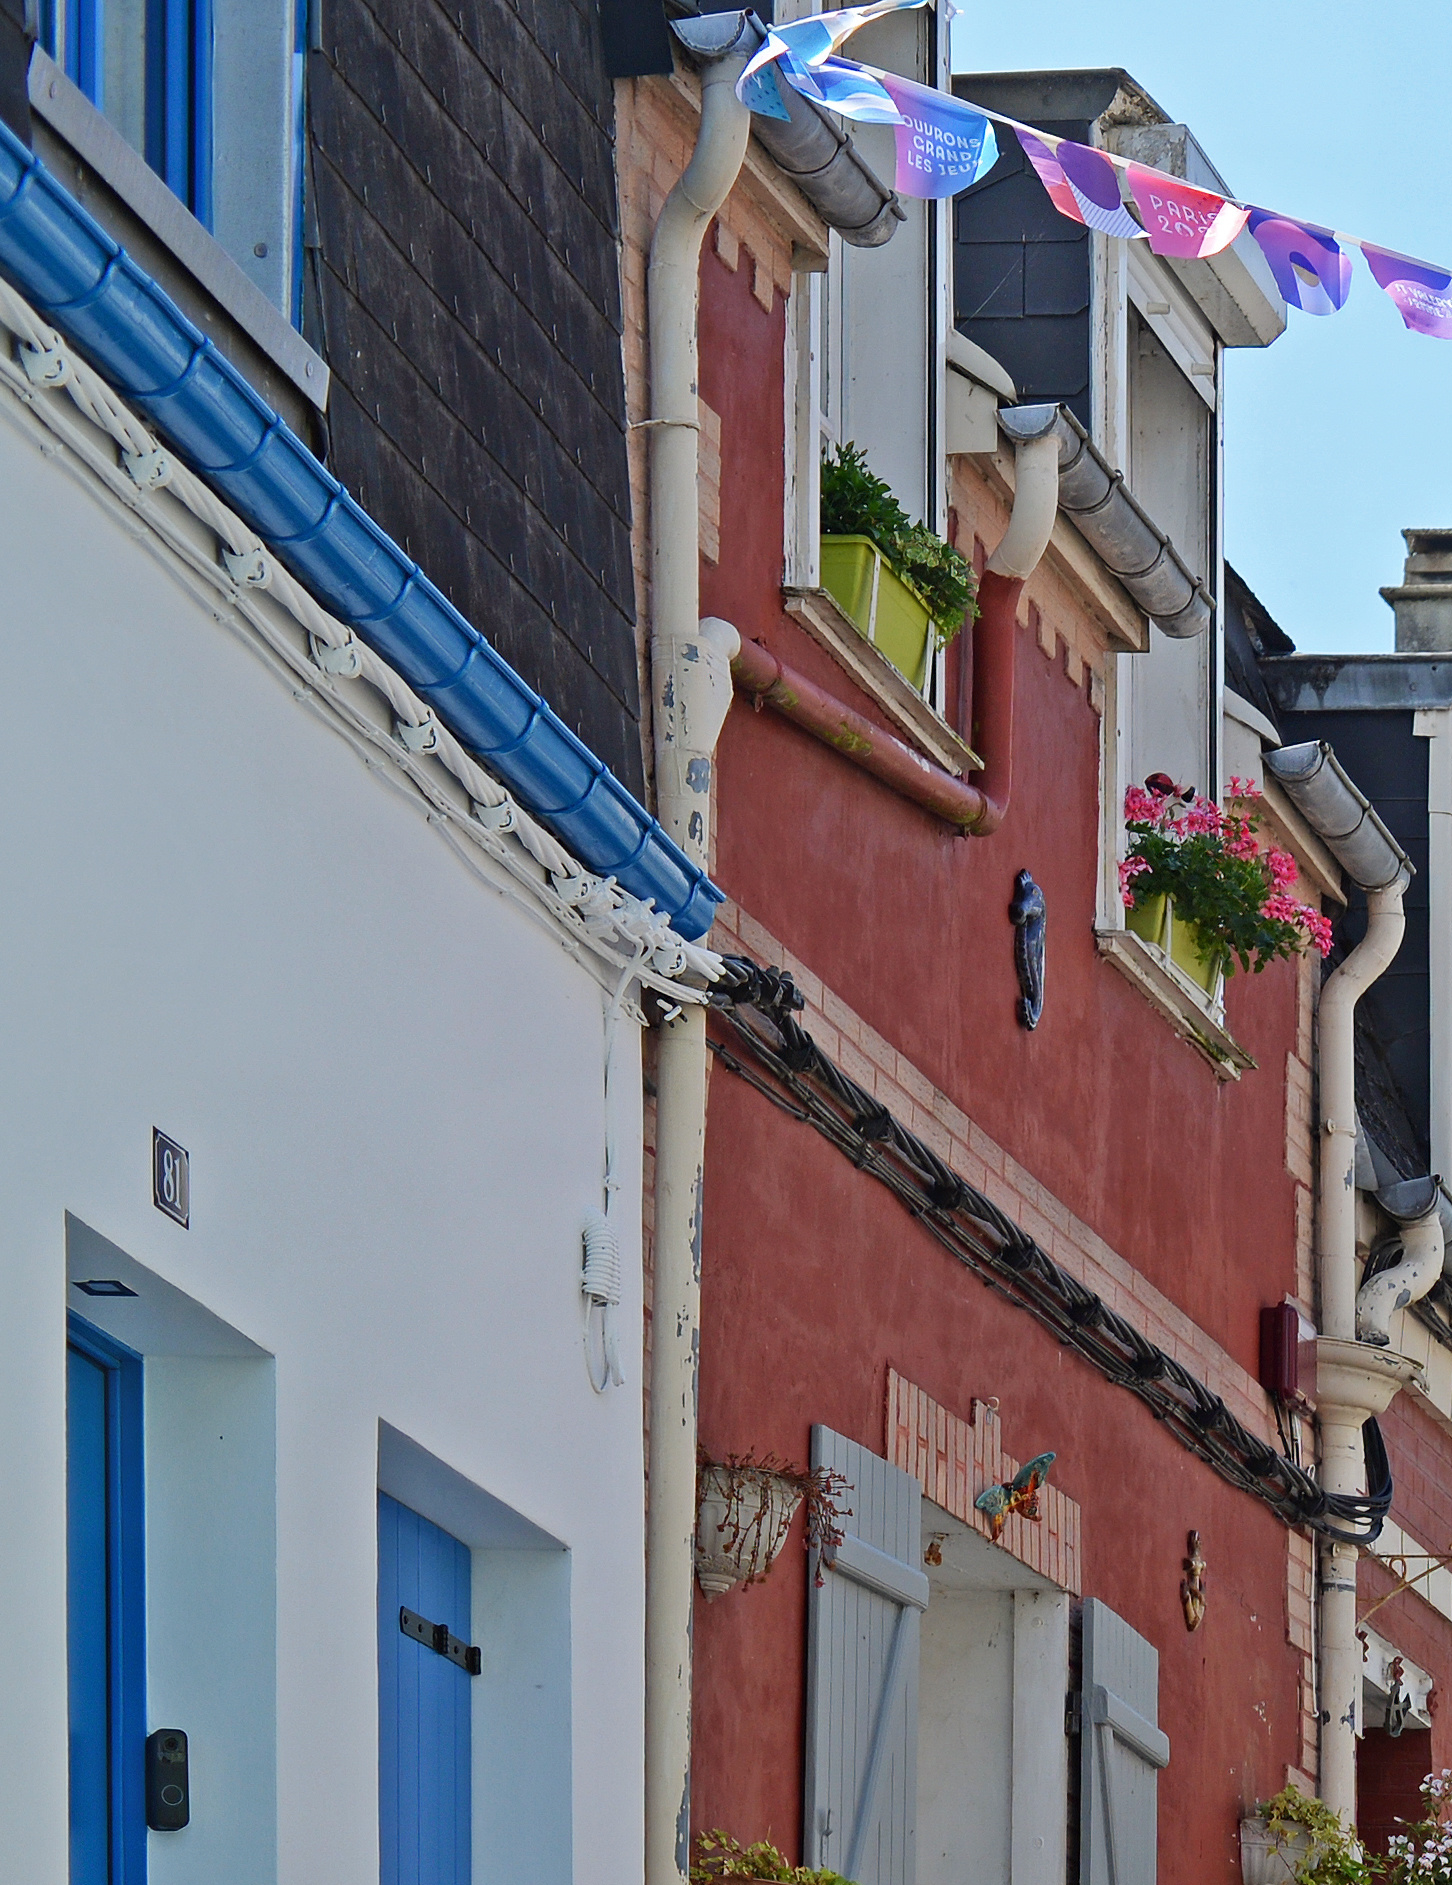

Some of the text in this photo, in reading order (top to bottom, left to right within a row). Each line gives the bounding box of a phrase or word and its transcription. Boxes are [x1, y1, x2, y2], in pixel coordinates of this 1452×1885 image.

[907, 150, 933, 173] LES
[912, 135, 972, 162] GRAND
[163, 1149, 182, 1210] 81
